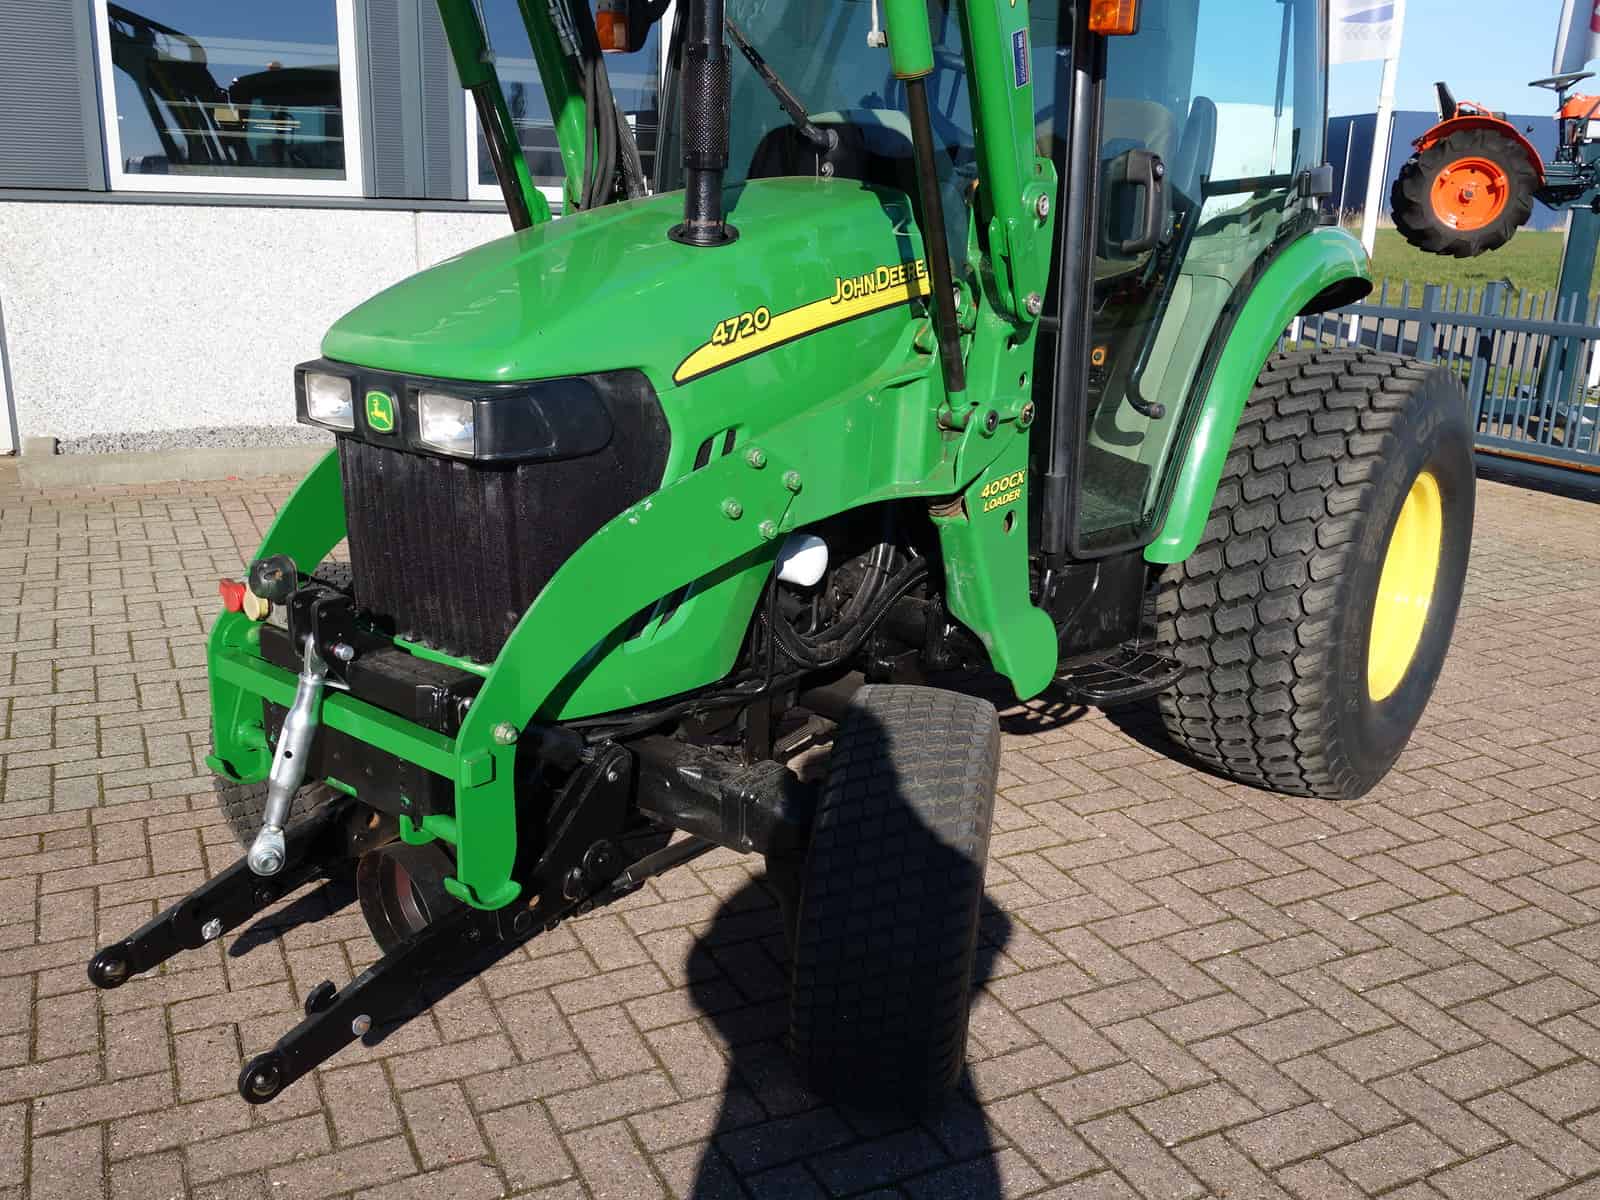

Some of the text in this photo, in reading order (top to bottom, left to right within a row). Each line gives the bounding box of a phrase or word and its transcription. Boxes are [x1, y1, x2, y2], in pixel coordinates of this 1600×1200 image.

[831, 259, 925, 304] JOHN DEERE
[711, 306, 770, 347] 4720
[980, 470, 1025, 498] 400CX
[983, 488, 1021, 513] LOADER
